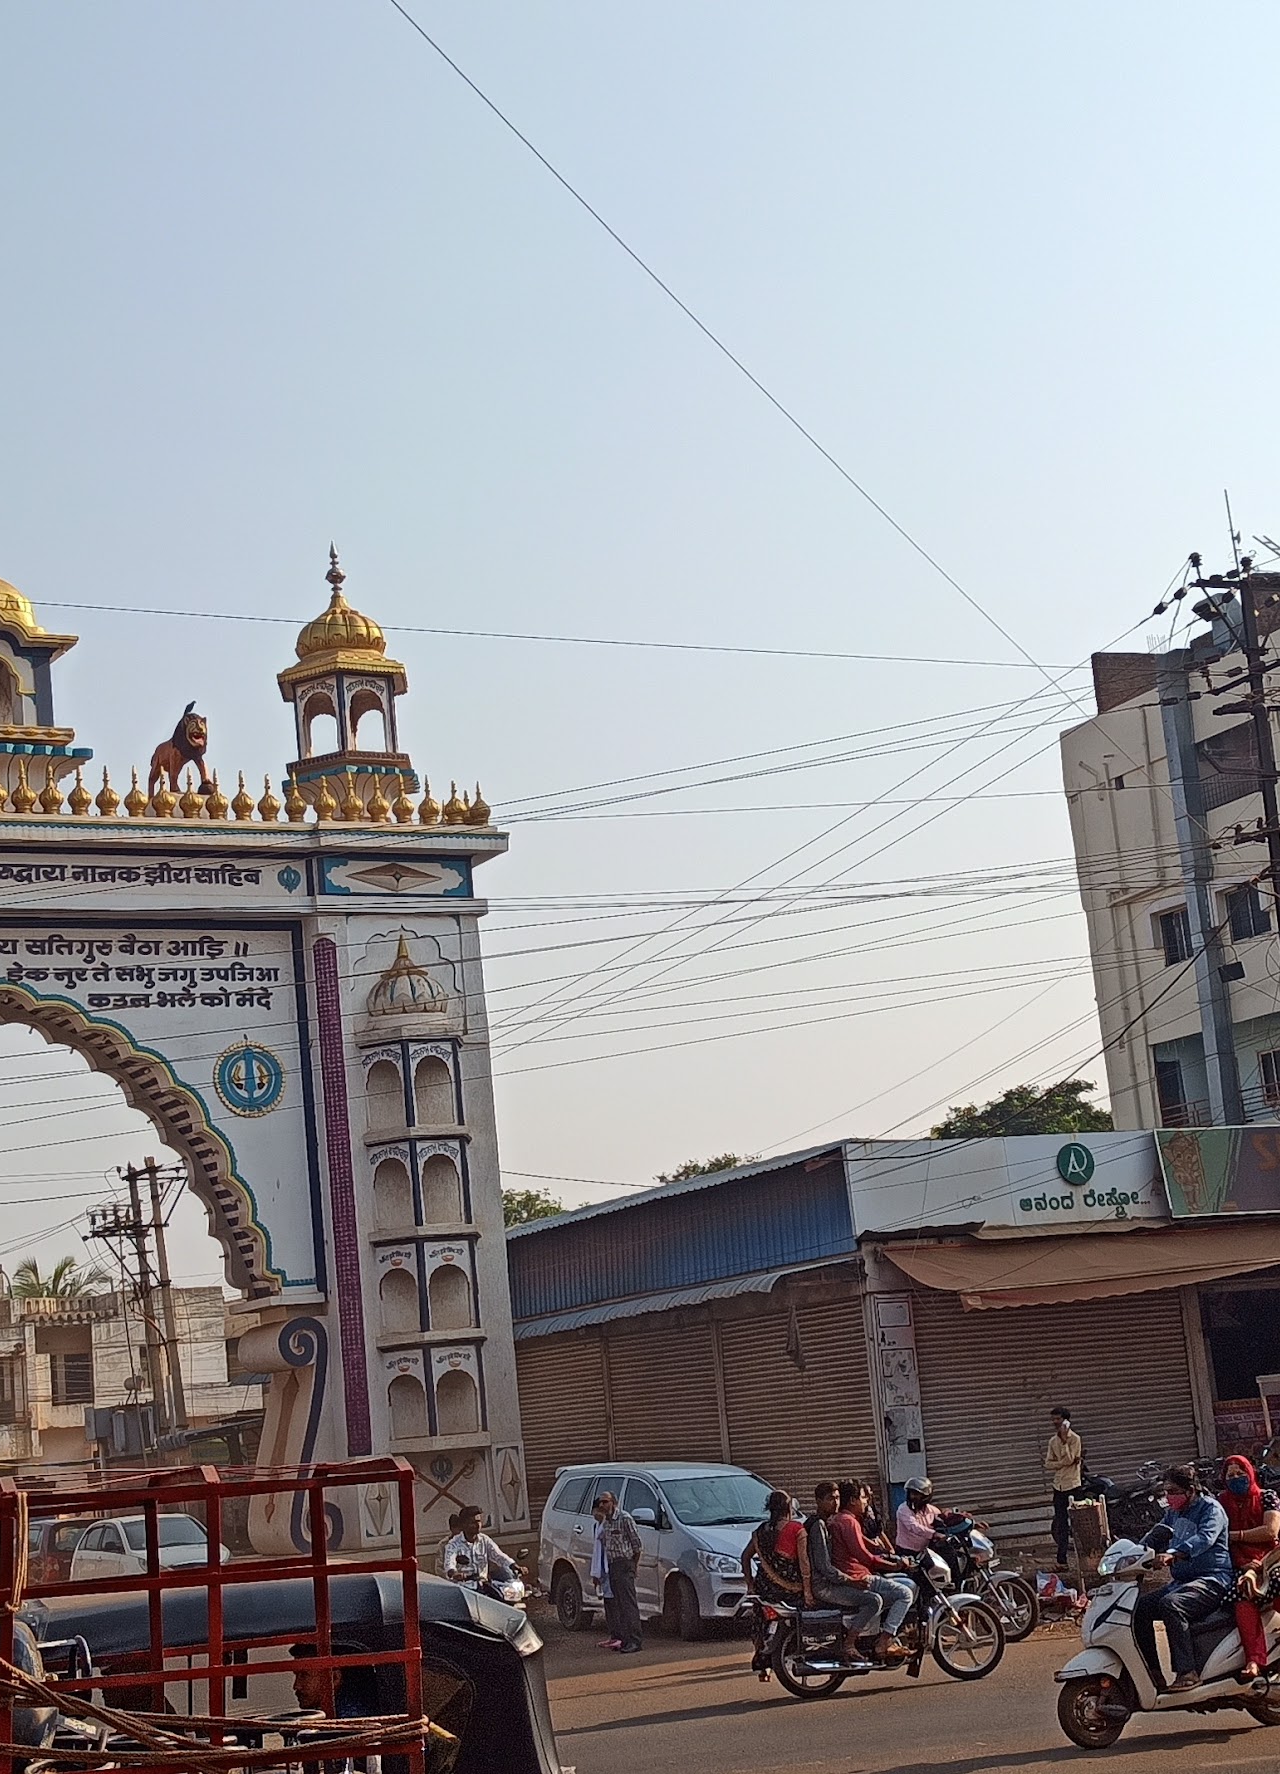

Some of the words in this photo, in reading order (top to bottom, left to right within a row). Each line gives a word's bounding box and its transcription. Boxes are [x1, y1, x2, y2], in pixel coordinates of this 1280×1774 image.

[71, 864, 141, 884] नानक
[195, 865, 261, 886] साहिब
[25, 934, 112, 963] सतिगुरु
[118, 934, 163, 956] बैठा
[52, 966, 88, 989] नुर
[90, 962, 111, 982] ते
[115, 965, 156, 989] सभु
[158, 966, 198, 988] जगु
[200, 962, 279, 982] उपजिआ
[156, 987, 196, 1008] भले
[200, 986, 230, 1008] को
[236, 988, 273, 1010] मंदे
[1020, 1192, 1074, 1212] ಆನಂದ
